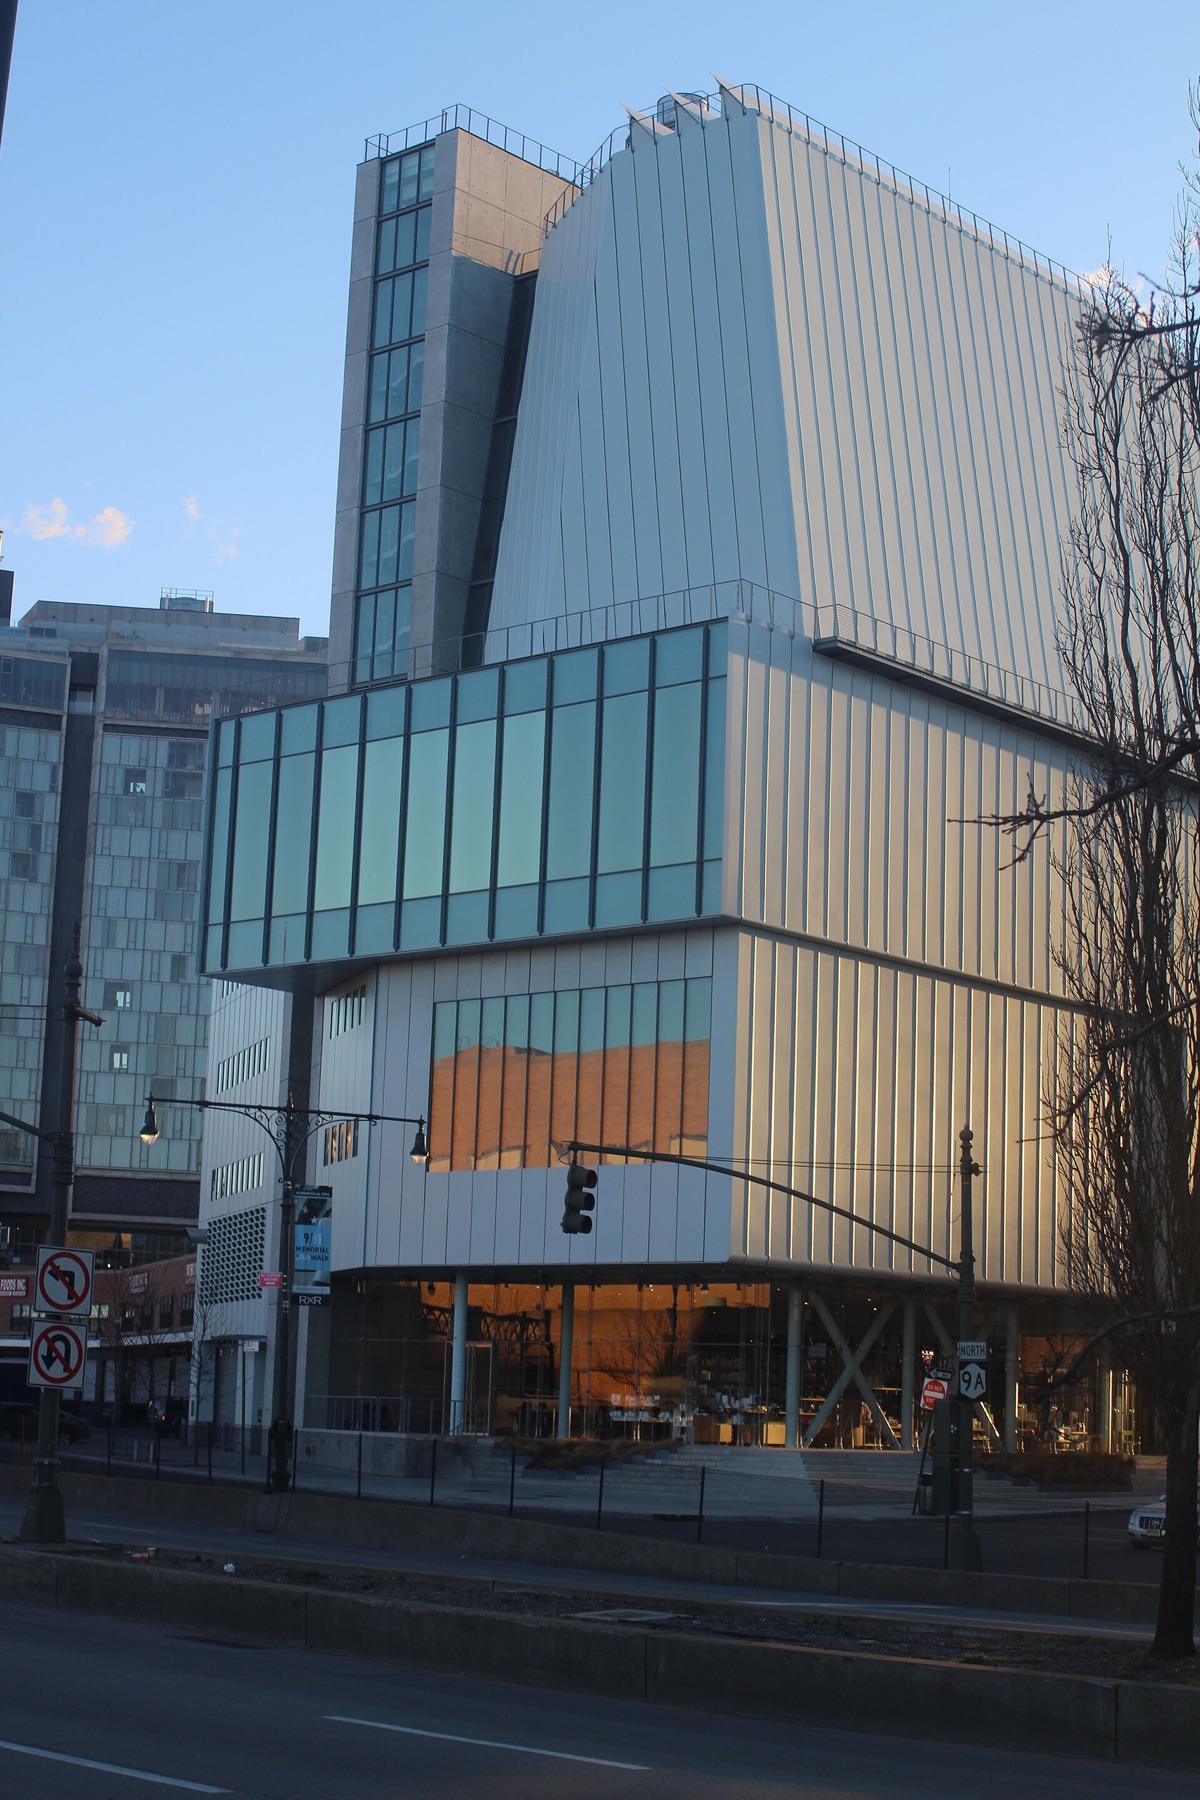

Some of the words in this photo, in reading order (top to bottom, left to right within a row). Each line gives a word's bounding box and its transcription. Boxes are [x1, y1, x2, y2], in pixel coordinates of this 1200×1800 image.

[304, 1232, 322, 1245] 9/11
[299, 1295, 321, 1305] RXR
[960, 1345, 985, 1356] NORTH
